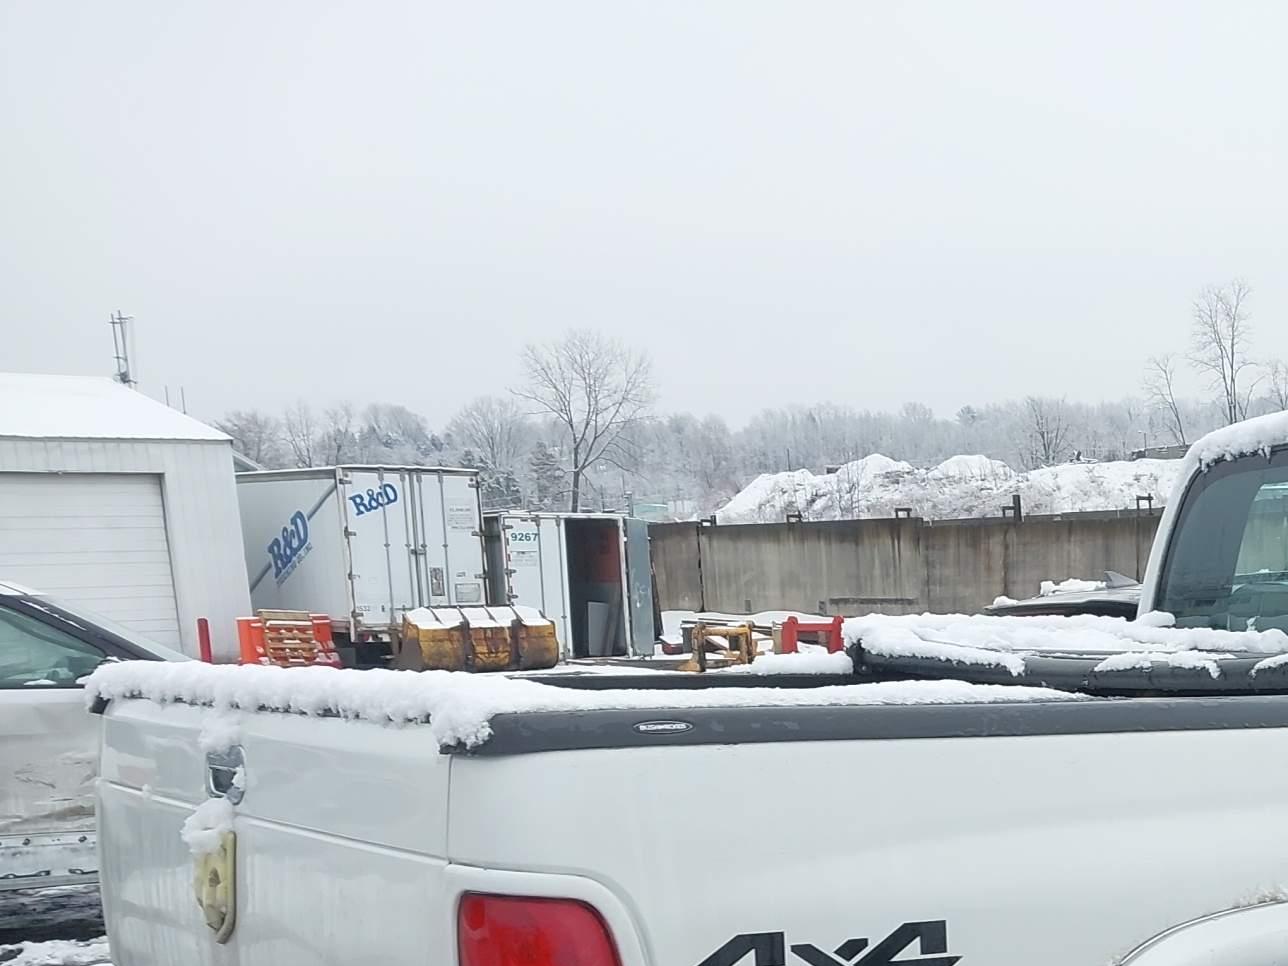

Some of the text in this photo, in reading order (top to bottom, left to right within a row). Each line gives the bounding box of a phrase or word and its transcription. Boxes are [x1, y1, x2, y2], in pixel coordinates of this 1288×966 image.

[348, 483, 398, 516] R&D
[267, 511, 308, 579] R&D
[511, 533, 538, 542] 9267
